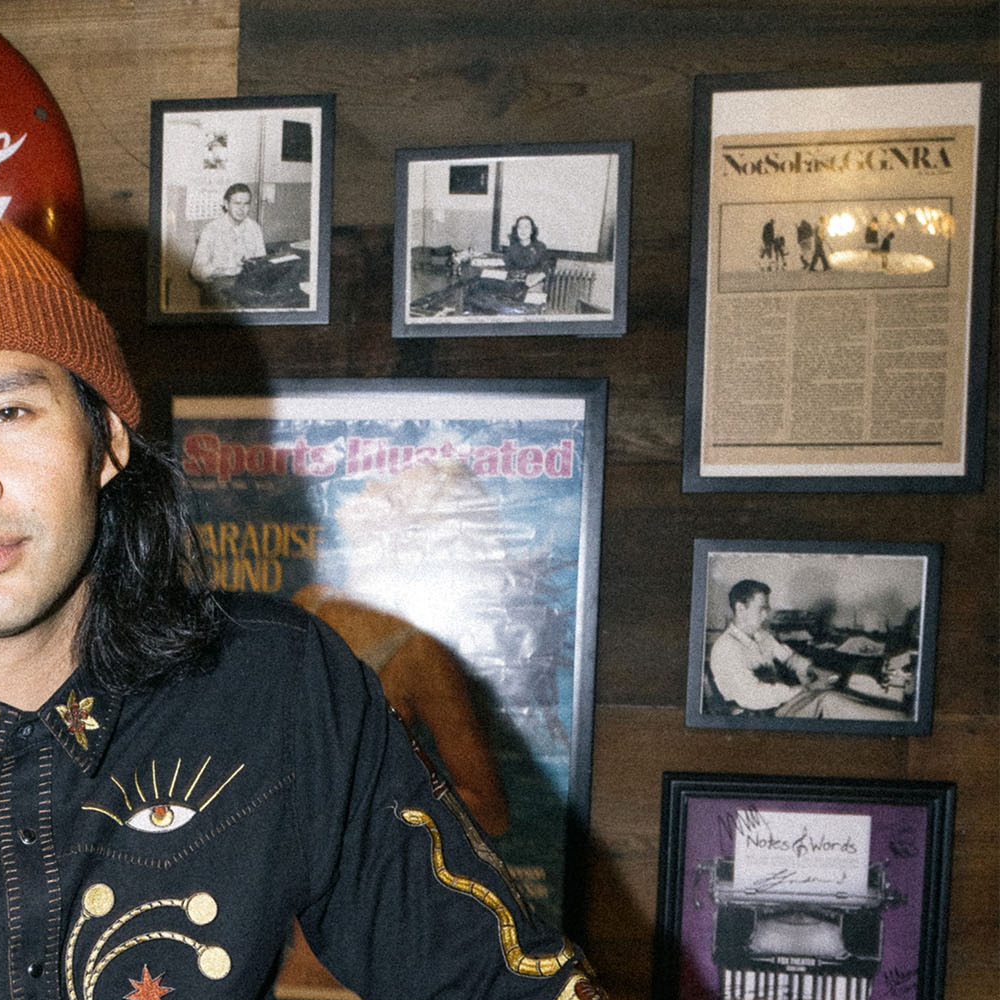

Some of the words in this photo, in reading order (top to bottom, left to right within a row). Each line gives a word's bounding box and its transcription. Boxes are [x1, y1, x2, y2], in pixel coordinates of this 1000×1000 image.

[182, 432, 338, 483] Sports
[345, 435, 575, 479] Illustated
[184, 521, 326, 559] ARADISE
[746, 832, 789, 851] Notes
[809, 834, 858, 855] Words
